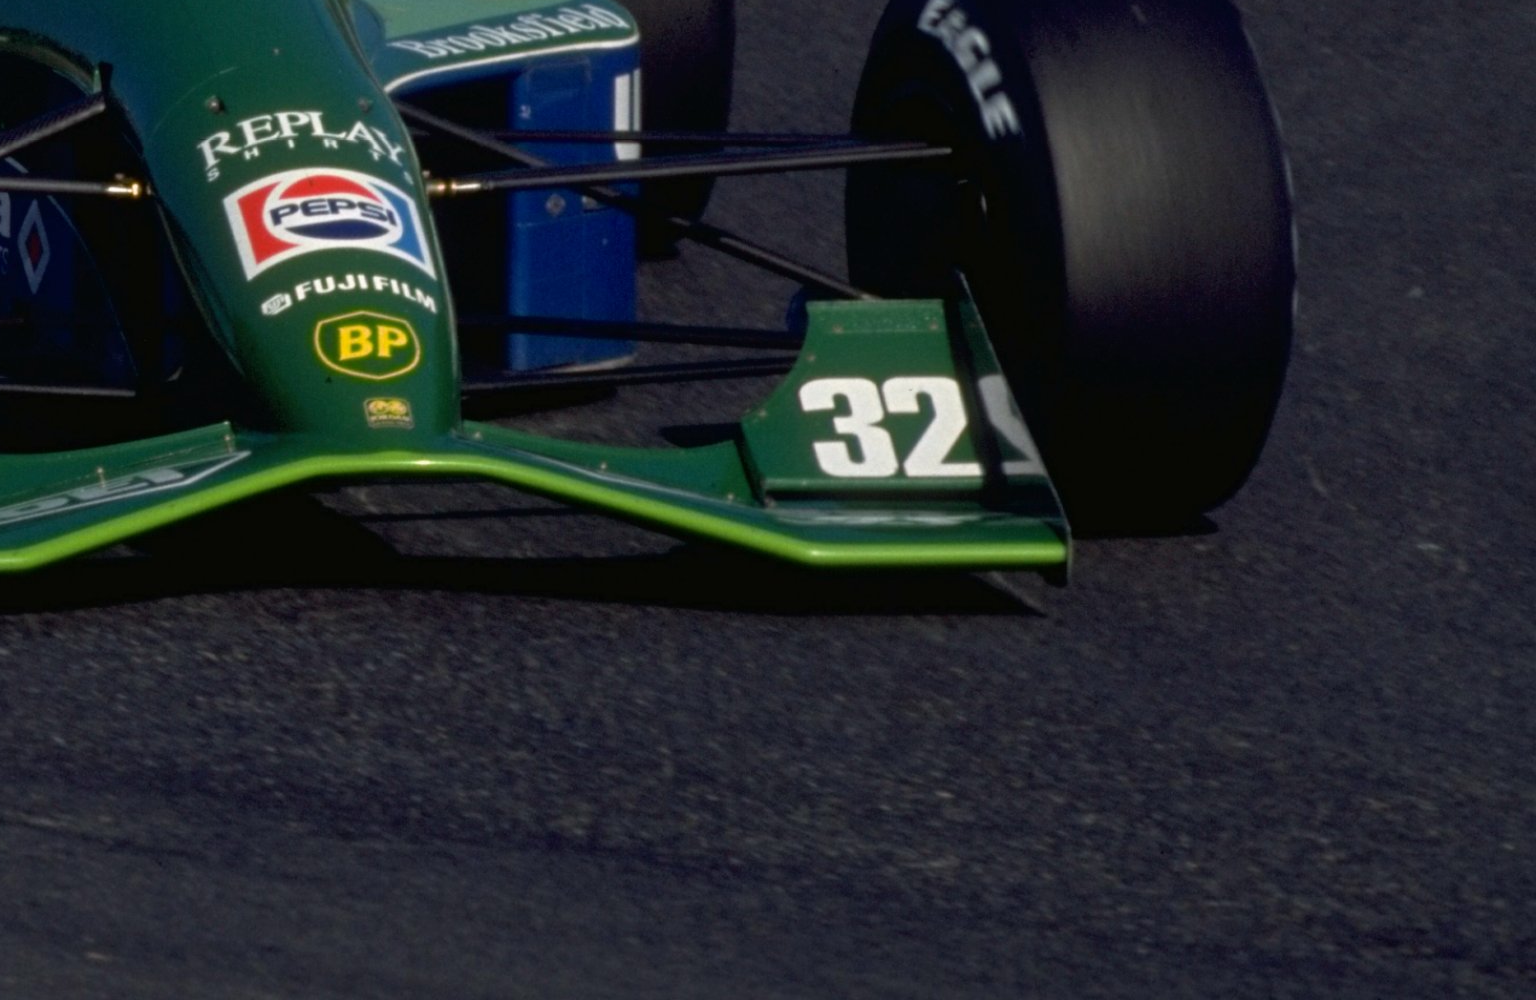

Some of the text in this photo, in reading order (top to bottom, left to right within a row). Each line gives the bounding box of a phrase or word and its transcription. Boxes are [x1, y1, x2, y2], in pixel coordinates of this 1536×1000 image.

[387, 3, 631, 59] Brooksfield
[196, 110, 406, 170] REPLAY
[269, 198, 398, 226] PEPSI
[338, 324, 409, 361] BP
[798, 376, 984, 479] 32
